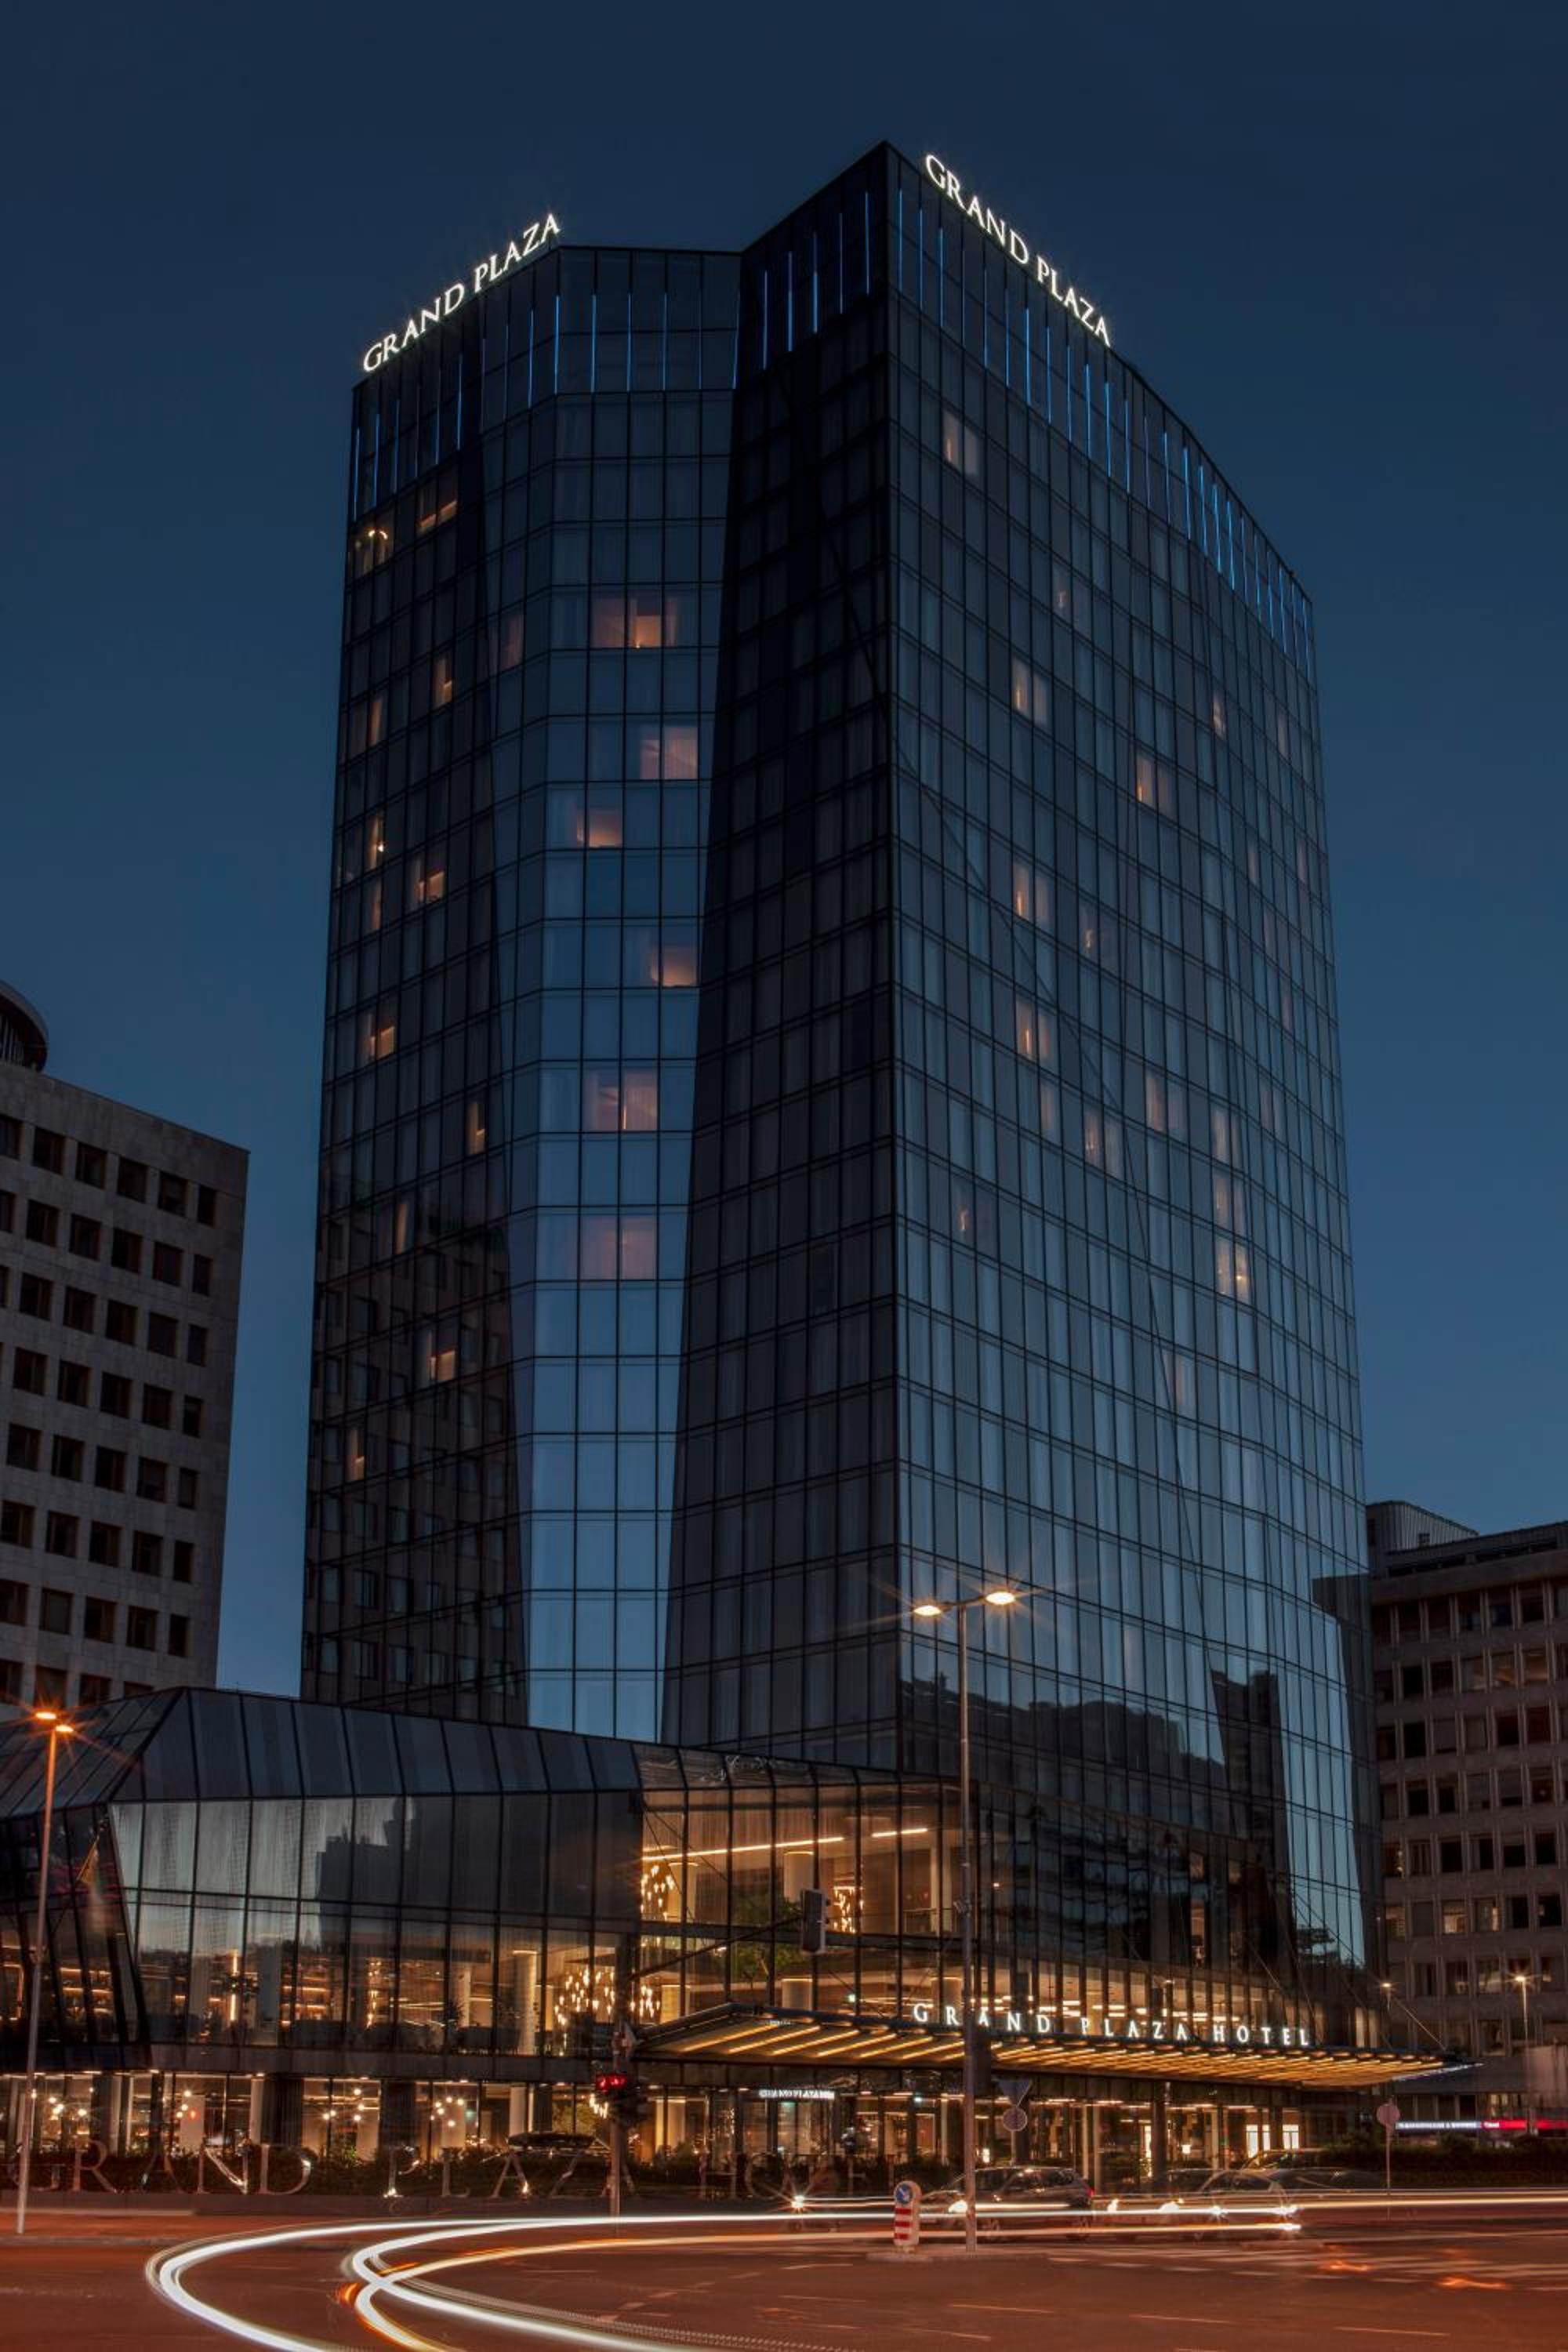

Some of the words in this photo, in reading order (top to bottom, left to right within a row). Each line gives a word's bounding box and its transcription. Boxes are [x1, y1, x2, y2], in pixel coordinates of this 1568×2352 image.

[363, 282, 465, 372] GRAND
[474, 213, 561, 293] PLAZA
[926, 154, 1029, 265] GRAND
[1036, 255, 1110, 347] PLAZA
[913, 2002, 1051, 2034] GRAND
[1080, 2017, 1189, 2041] PLAZA
[1212, 2025, 1309, 2046] HOTEL
